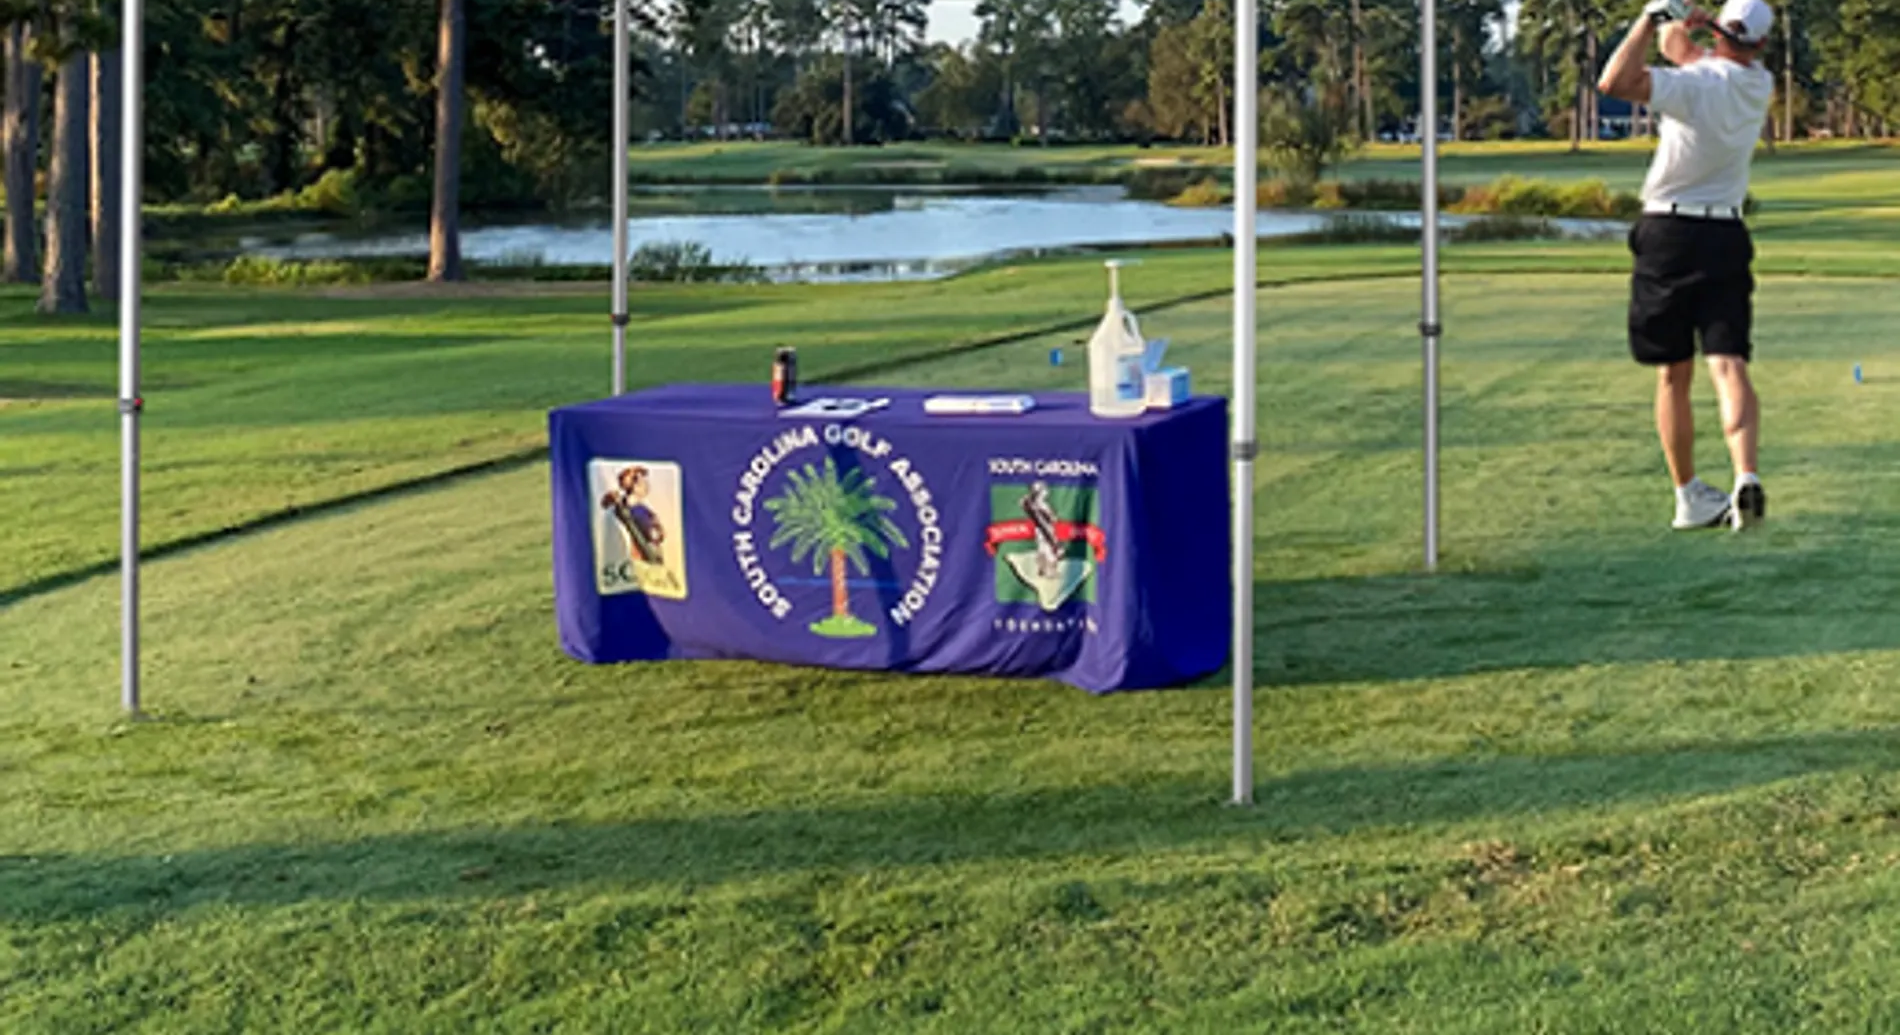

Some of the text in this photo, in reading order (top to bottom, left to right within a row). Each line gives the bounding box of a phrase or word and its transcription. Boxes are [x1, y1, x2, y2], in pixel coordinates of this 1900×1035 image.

[732, 423, 943, 626] SOUTH CAROLINA GOLF ASSOCIATION
